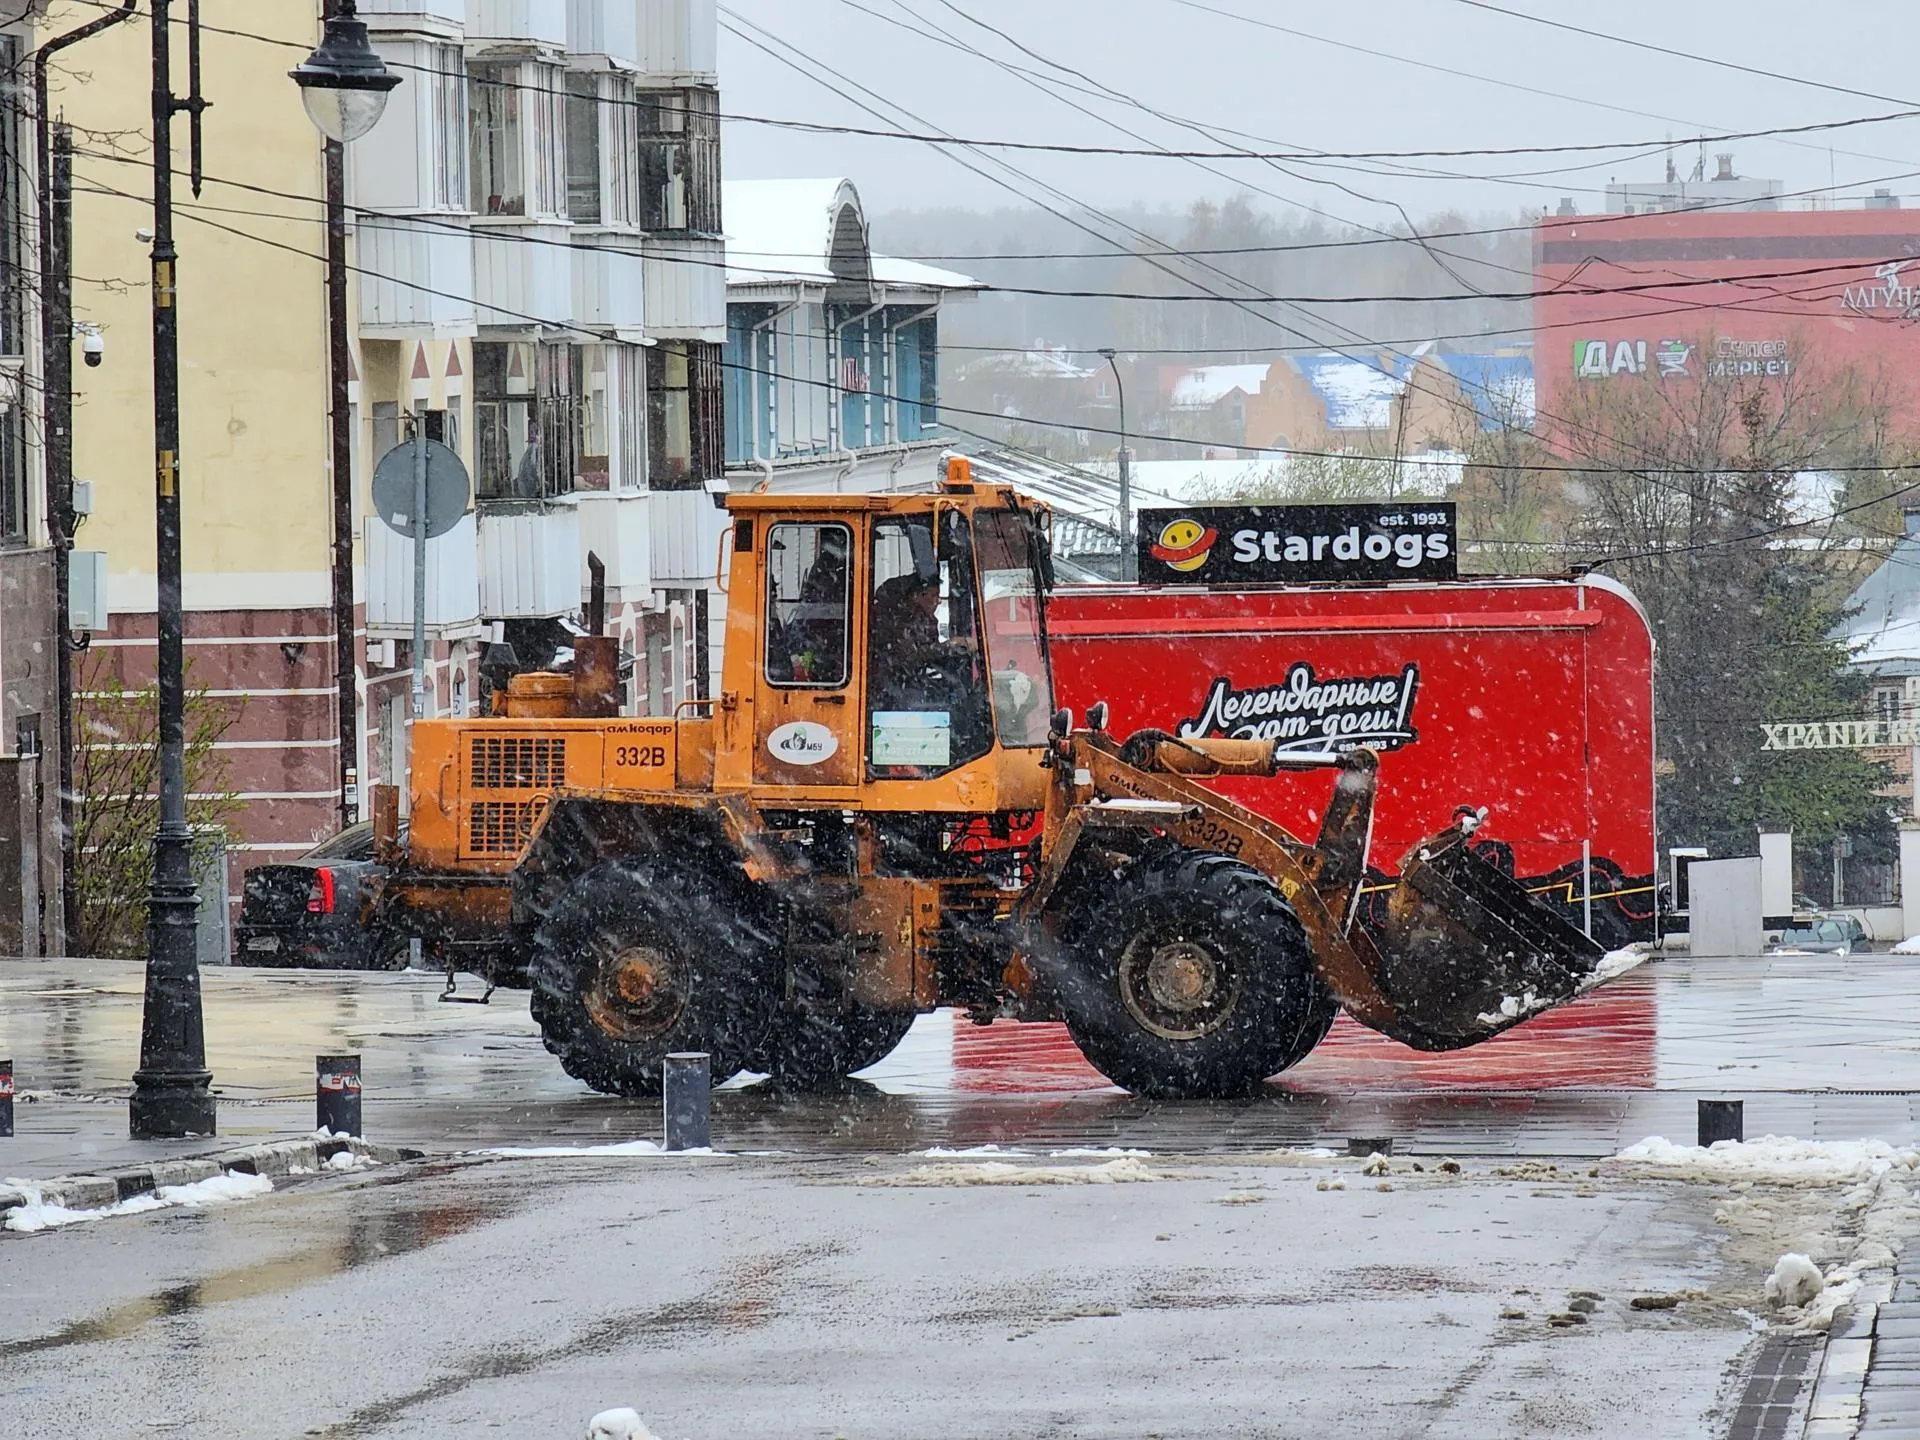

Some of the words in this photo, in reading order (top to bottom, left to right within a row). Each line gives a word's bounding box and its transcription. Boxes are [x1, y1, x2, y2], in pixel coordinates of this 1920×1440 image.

[1840, 286, 1920, 308] ЛАГУН
[1579, 341, 1647, 377] ДА!
[1379, 514, 1408, 526] est.
[1412, 512, 1447, 526] 1993
[1233, 526, 1449, 568] Stardogs
[1181, 667, 1398, 739] Легендарные
[1338, 743, 1357, 752] est
